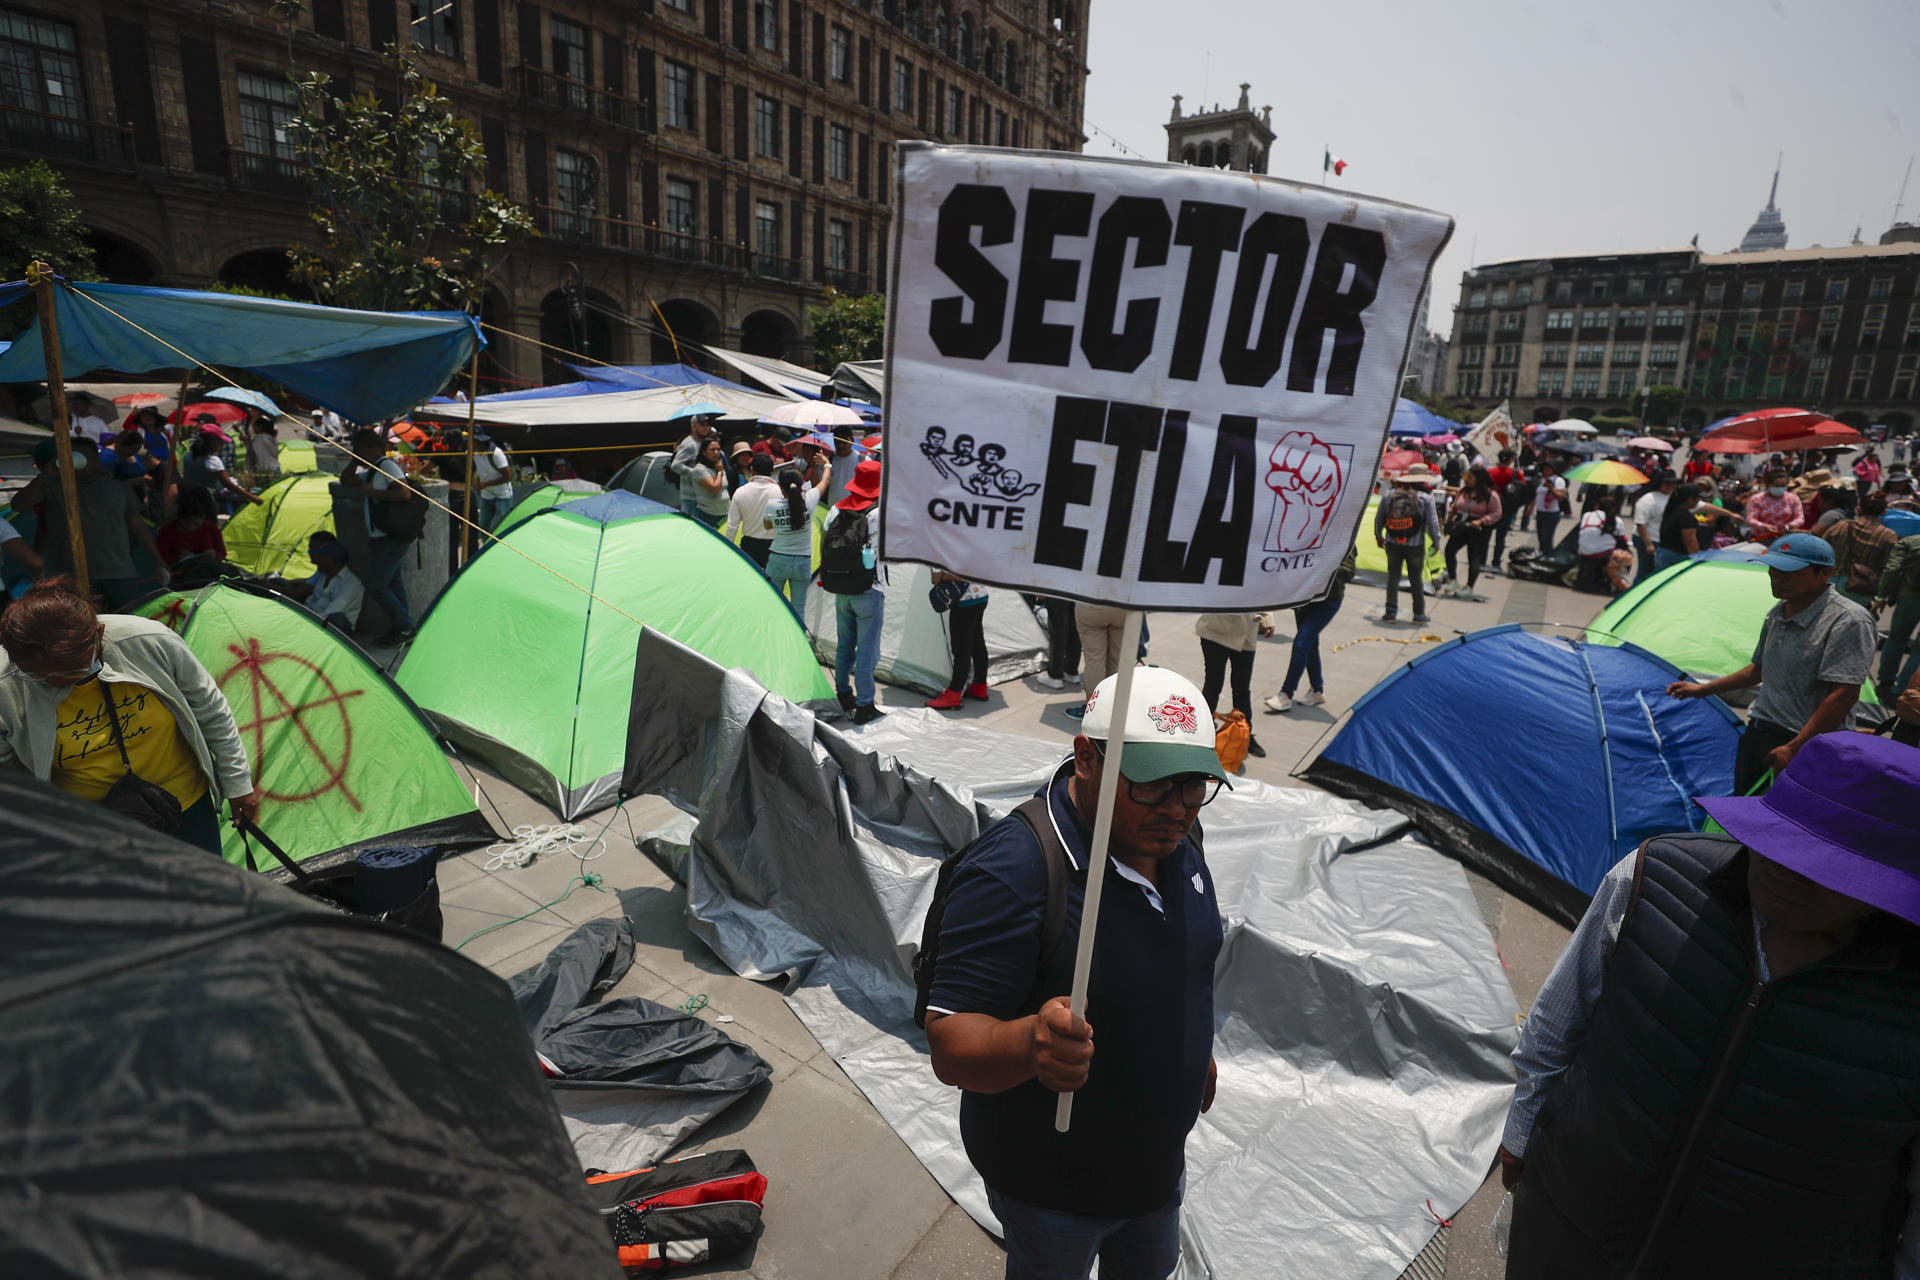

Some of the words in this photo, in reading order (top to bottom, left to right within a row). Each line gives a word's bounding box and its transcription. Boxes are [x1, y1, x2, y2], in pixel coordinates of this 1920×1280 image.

[929, 183, 1387, 396] SECTOR
[927, 498, 1025, 531] CNTE
[1033, 395, 1258, 586] ETLA
[1261, 552, 1315, 572] CNTE
